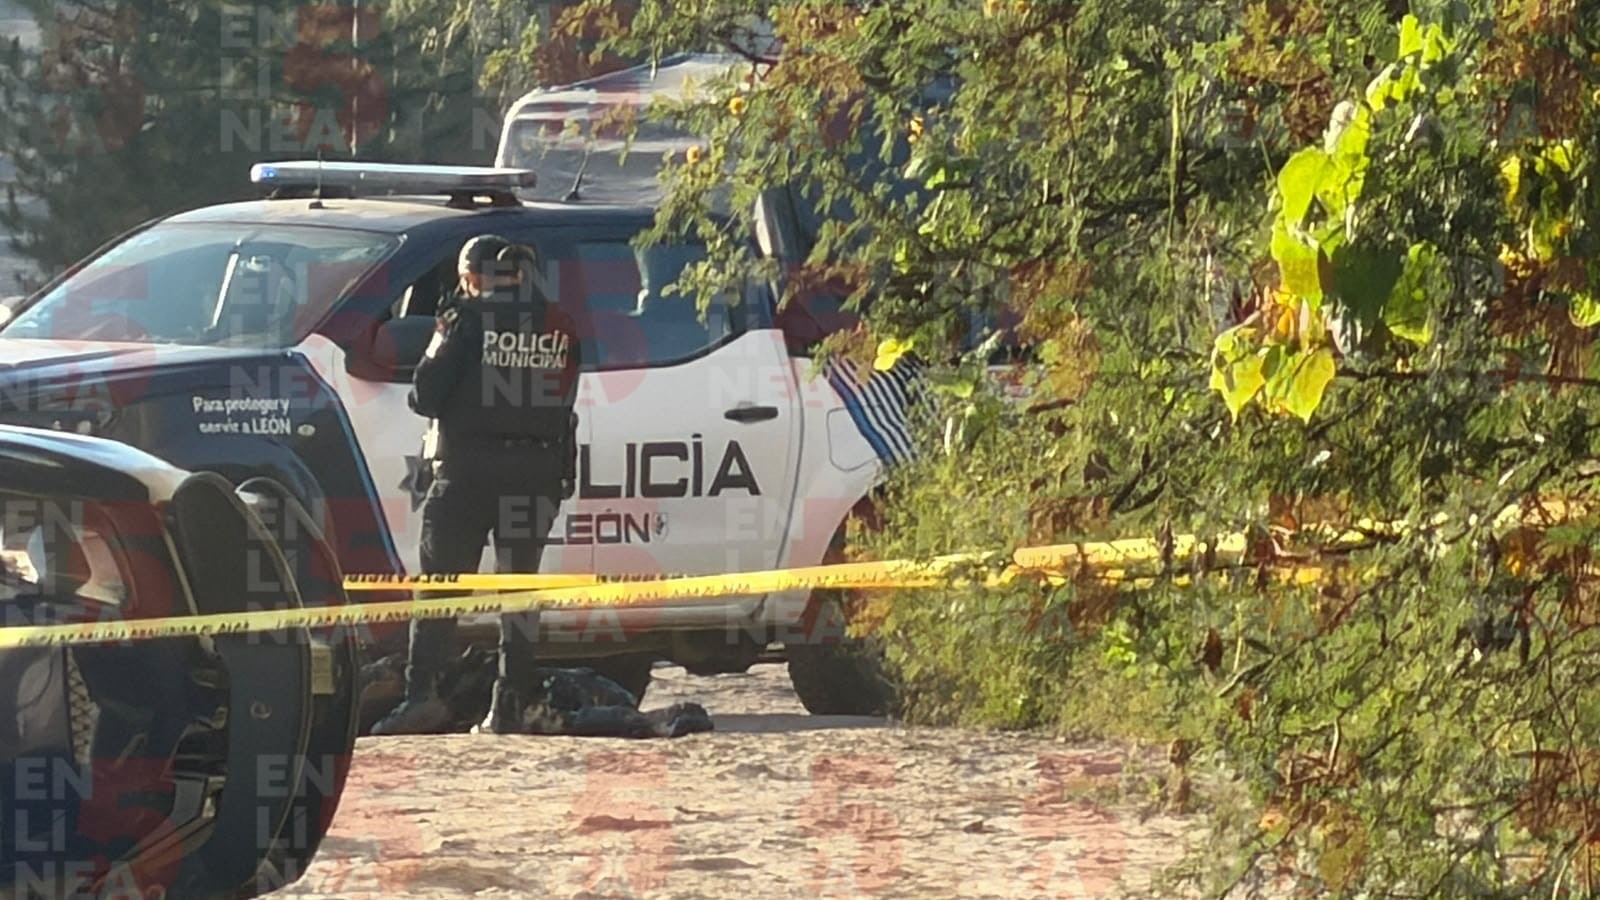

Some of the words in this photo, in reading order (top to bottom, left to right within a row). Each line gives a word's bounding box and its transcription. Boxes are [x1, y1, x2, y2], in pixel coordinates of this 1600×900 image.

[192, 396, 225, 413] Para
[224, 397, 280, 415] proteger
[252, 414, 292, 435] LEÓN
[579, 433, 761, 499] LICÍA
[547, 508, 650, 545] EÓN
